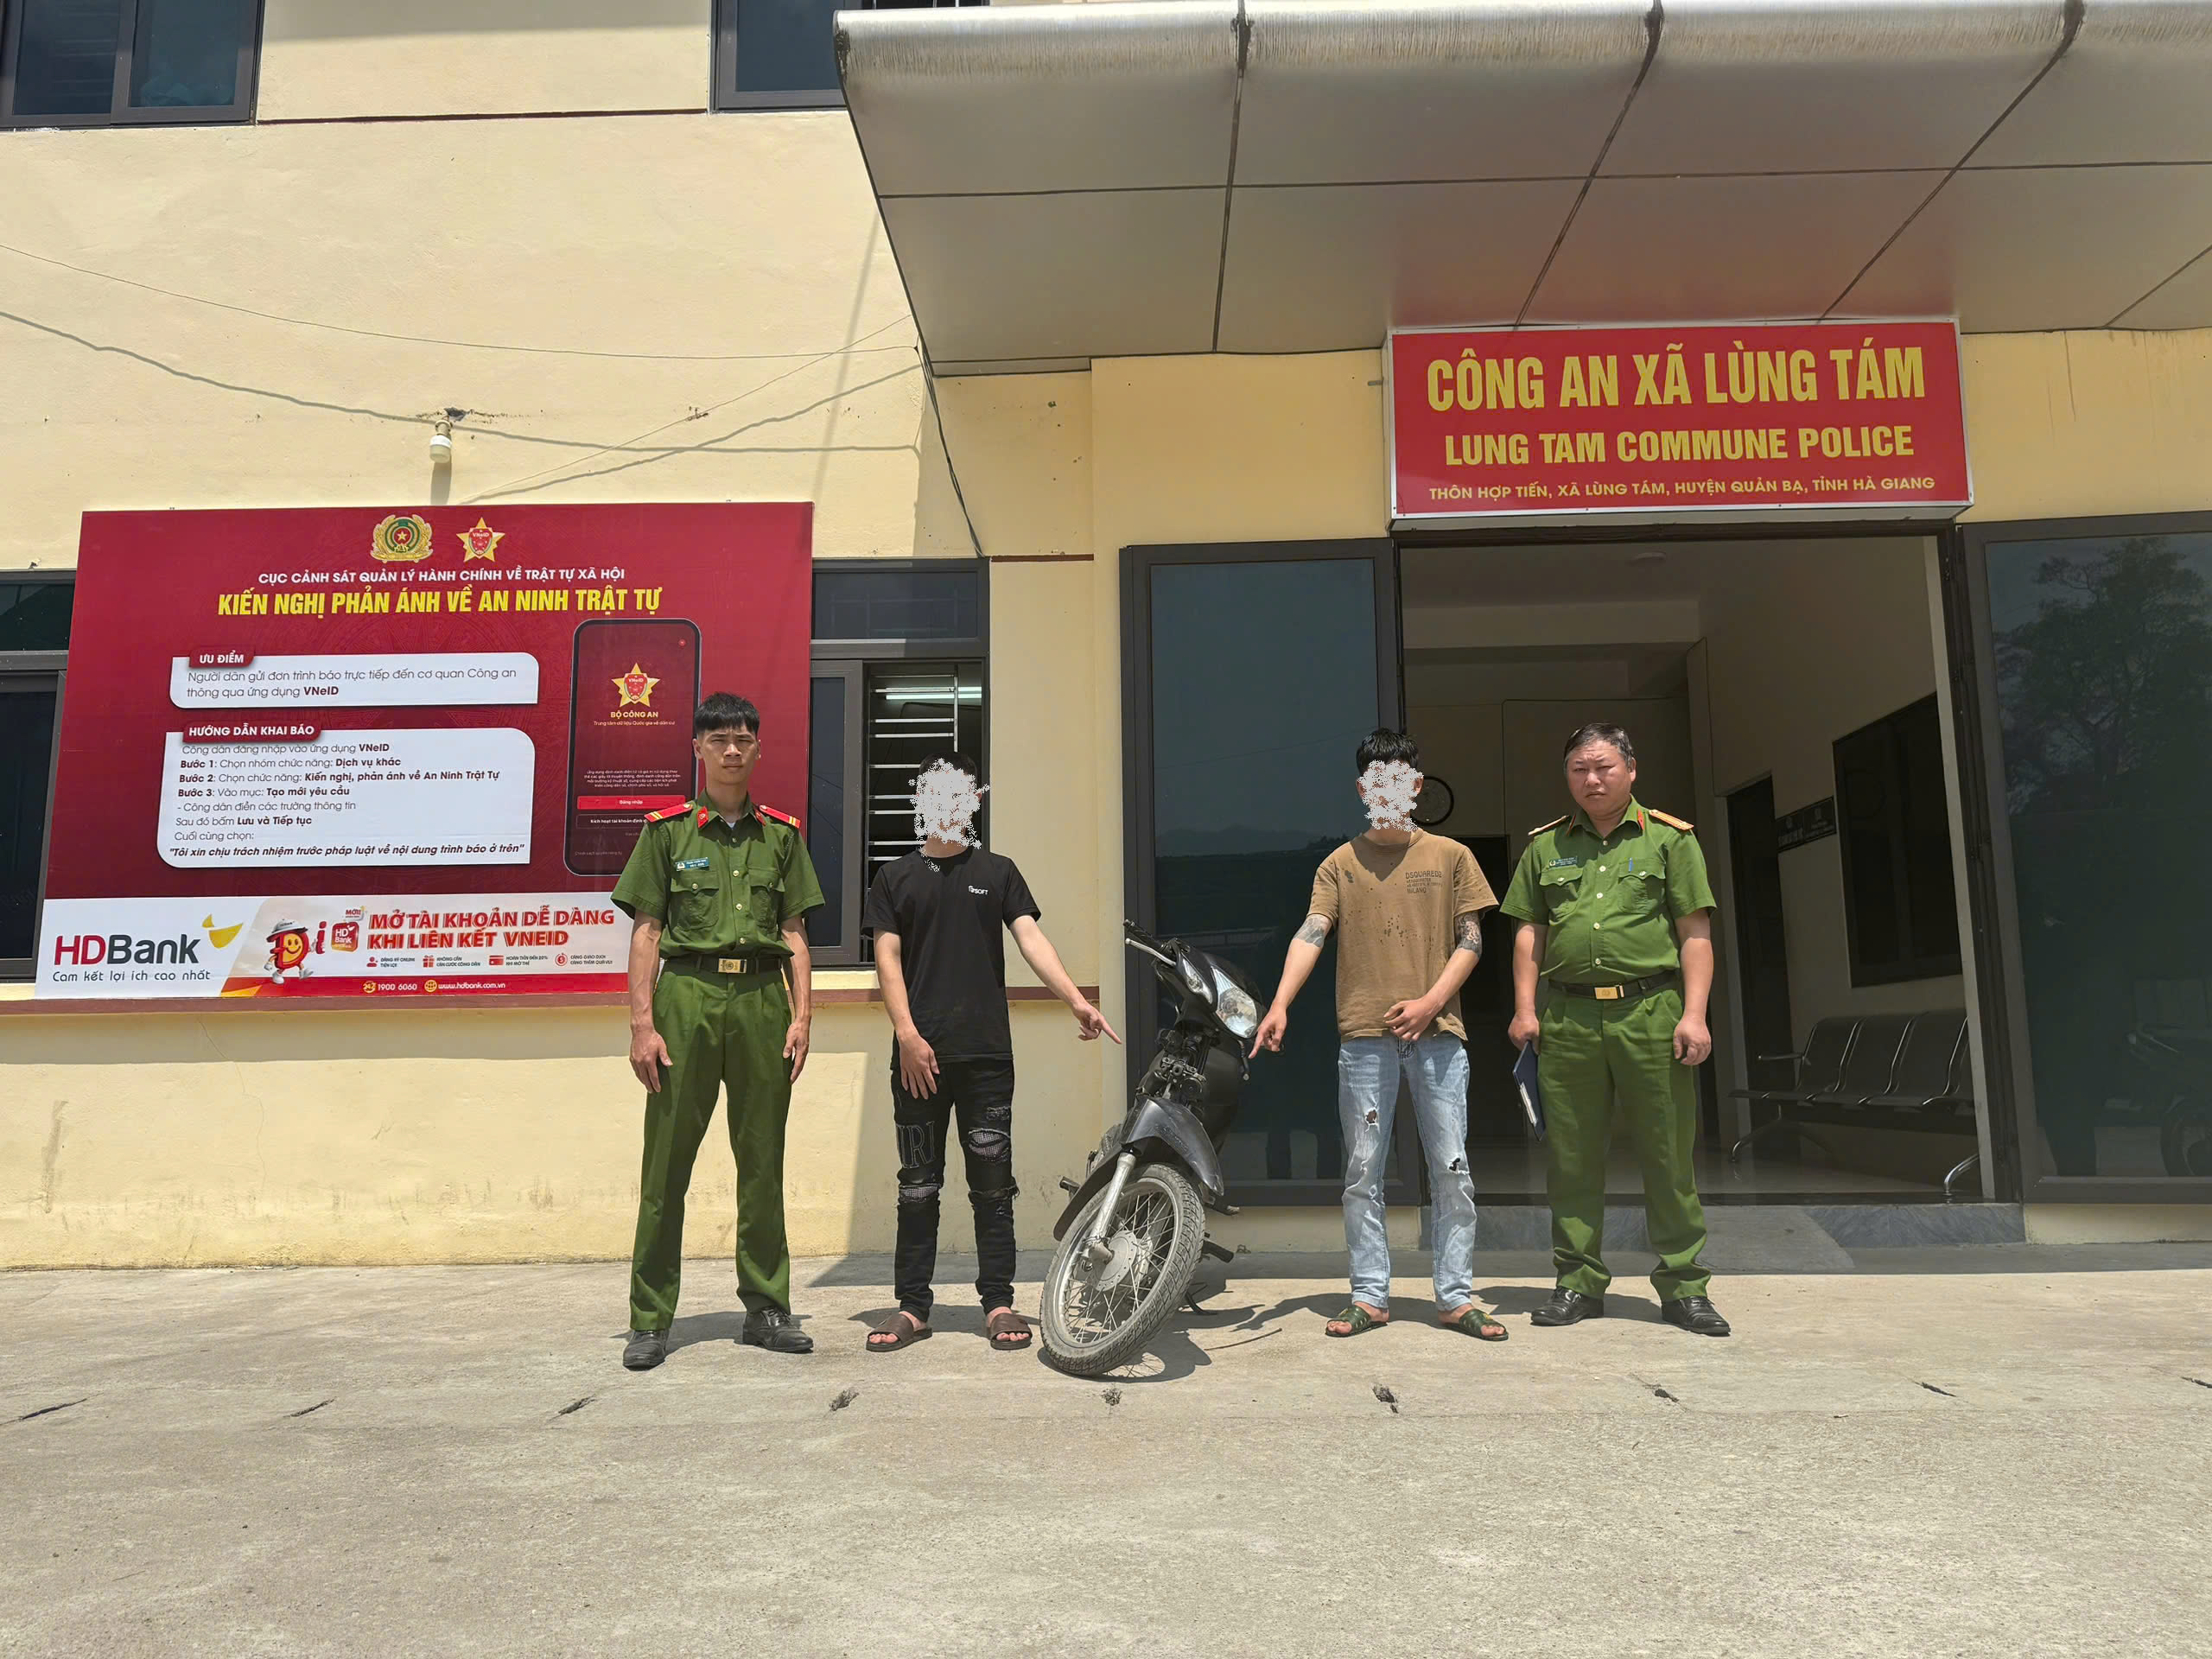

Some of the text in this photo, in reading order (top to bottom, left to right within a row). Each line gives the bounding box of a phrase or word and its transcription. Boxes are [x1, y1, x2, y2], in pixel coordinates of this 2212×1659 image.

[1427, 337, 1924, 411] CÔNG AN XÃ LÙNG TÁM
[1445, 426, 1914, 465] LUNG TAM COMMUNE POLICE
[1430, 476, 1935, 501] THÔN HỢP TIẾN, XÃ LÙNG TÁM, HUYỆN QUẢN BẠ, TỈNH HÀ GIANG
[259, 565, 625, 586] CỤC CẢNH SÁT QUẢN LÝ HÀNH CHÍNH VỀ TRẬT TỰ XÃ HỘI
[218, 584, 662, 619] KIẾN NGHỊ PHẢN ÁNH VỀ AN NINH TRẬT TỰ
[200, 651, 244, 663] ƯU ĐIỂM
[188, 672, 219, 683] Người
[224, 671, 245, 681] dân
[249, 671, 264, 683] gửi
[268, 671, 289, 681] đơn
[294, 671, 315, 680] trình
[319, 671, 341, 679] báo
[345, 671, 365, 681] trực
[369, 669, 389, 681] tiếp
[392, 668, 414, 678] đến
[417, 670, 432, 678] cơ
[435, 670, 464, 680] quan
[467, 668, 498, 679] Công
[188, 685, 339, 698] thông qua ứng dụng VNeID
[189, 722, 314, 735] HƯỚNG DẪN KHAI BÁO
[182, 746, 208, 755] Công
[233, 745, 258, 754] đăng
[262, 745, 286, 754] nhập
[310, 743, 327, 753] ứng
[331, 744, 355, 753] dụng
[181, 760, 206, 768] Bước
[249, 759, 276, 767] nhóm
[278, 759, 302, 767] chức
[305, 760, 333, 768] năng:
[336, 758, 358, 768] Dịch
[361, 760, 372, 768] vụ
[376, 757, 401, 766] khác
[180, 773, 204, 783] Bước
[219, 774, 245, 783] Chọn
[248, 772, 271, 782] chức
[275, 773, 302, 782] năng:
[305, 772, 327, 781] Kiến
[330, 772, 353, 783] nghị,
[358, 771, 383, 781] phản
[386, 772, 405, 780] ánh
[409, 770, 420, 780] về
[441, 771, 462, 779] Ninh
[467, 771, 485, 780] Trật
[488, 771, 499, 780] Tự
[178, 788, 203, 797] Bước
[240, 789, 264, 798] mục:
[267, 788, 284, 798] Tạo
[309, 787, 327, 797] yêu
[331, 785, 349, 795] cầu
[176, 817, 194, 826] Sau
[196, 817, 209, 826] đó
[213, 816, 234, 825] bấm
[273, 815, 293, 826] Tiếp
[296, 817, 312, 826] tục
[190, 848, 206, 856] xin
[209, 848, 230, 858] chịu
[233, 846, 259, 855] trách
[263, 847, 293, 857] nhiệm
[325, 846, 352, 856] pháp
[355, 845, 374, 855] luật
[378, 844, 390, 854] về
[393, 845, 408, 855] nội
[411, 846, 437, 855] dung
[441, 844, 463, 853] trình
[467, 844, 486, 853] báo
[490, 843, 497, 852] ở
[369, 906, 614, 930] MỞ TÀI KHOẢN DỄ DÀNG
[367, 928, 569, 950] KHI LIÊN KẾT VNEID
[54, 934, 200, 965] HDBank
[53, 972, 77, 982] Cam
[84, 970, 104, 981] kết
[111, 970, 124, 982] lợi
[131, 970, 148, 980] ích
[182, 969, 211, 980] nhất
